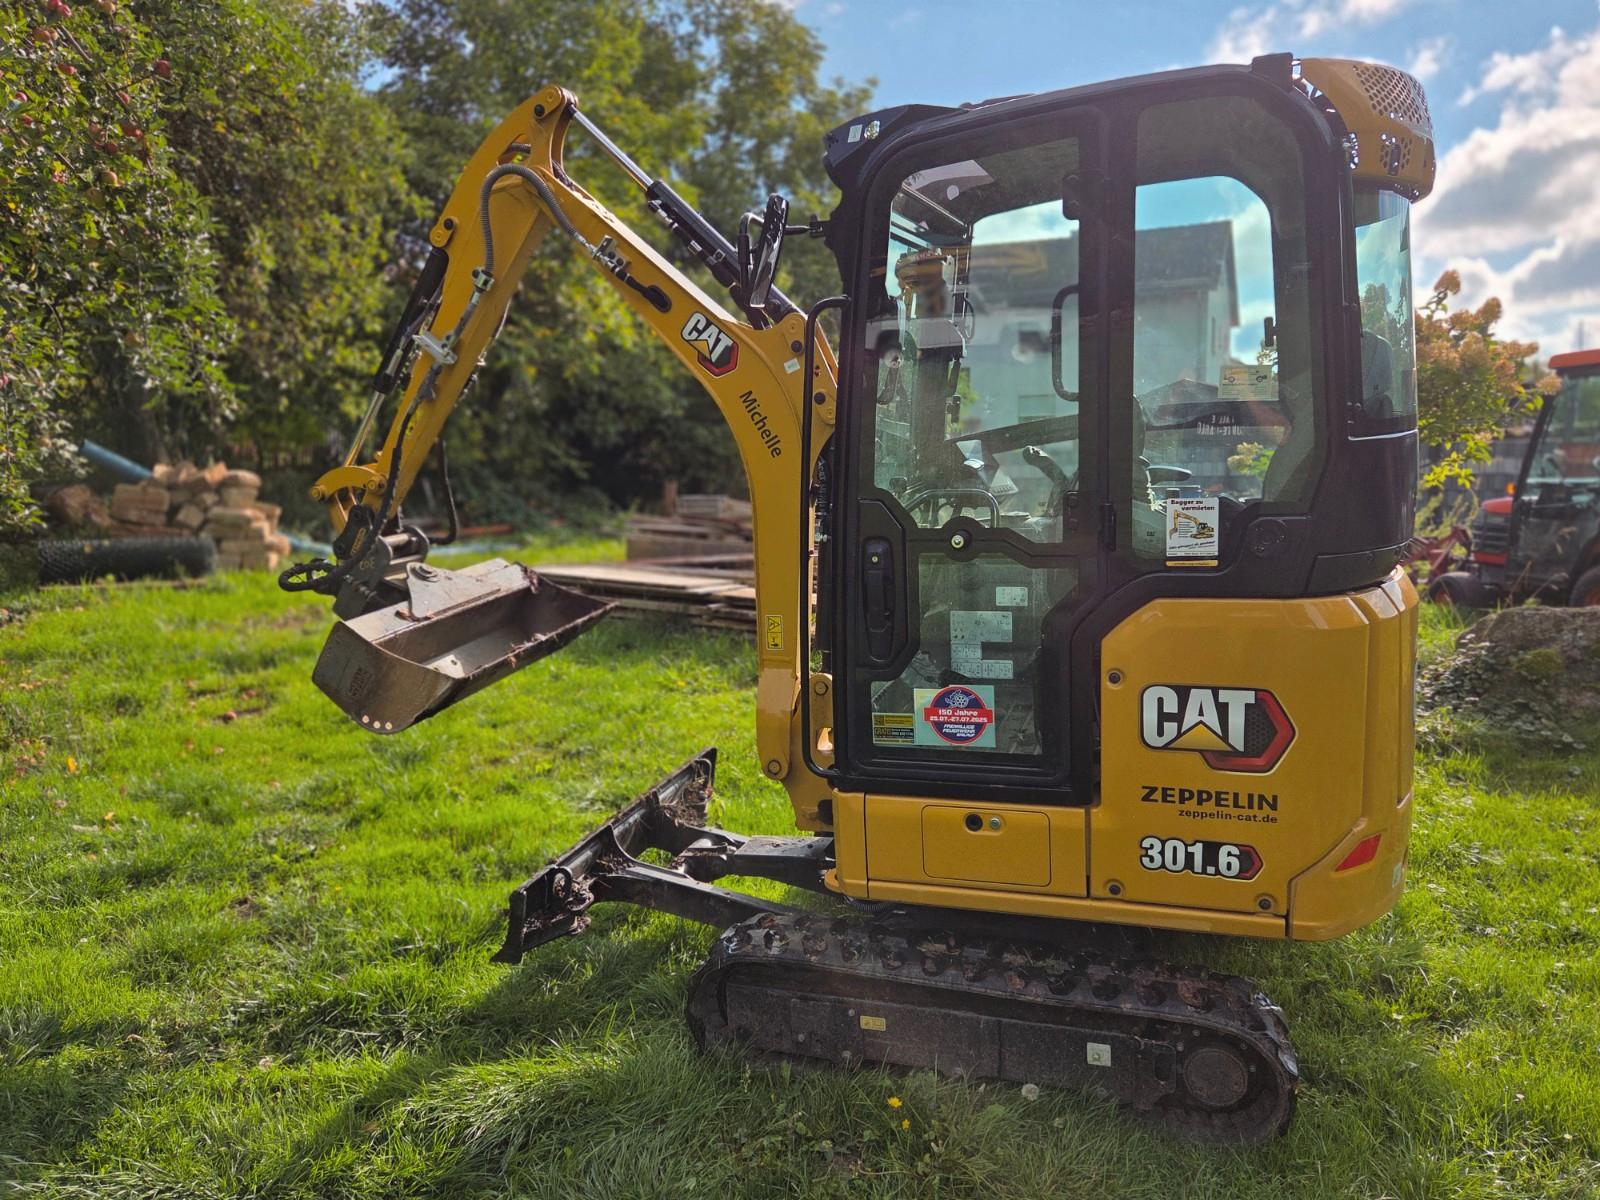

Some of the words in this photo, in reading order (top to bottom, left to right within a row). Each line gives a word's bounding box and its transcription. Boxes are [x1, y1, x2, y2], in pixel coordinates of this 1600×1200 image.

[682, 312, 734, 362] CAT
[739, 390, 782, 458] Michelle
[1143, 686, 1255, 752] CAT
[1141, 785, 1278, 811] ZEPPELIN
[1178, 809, 1278, 824] zeppelin-cat.de
[1141, 837, 1240, 877] 301.6
